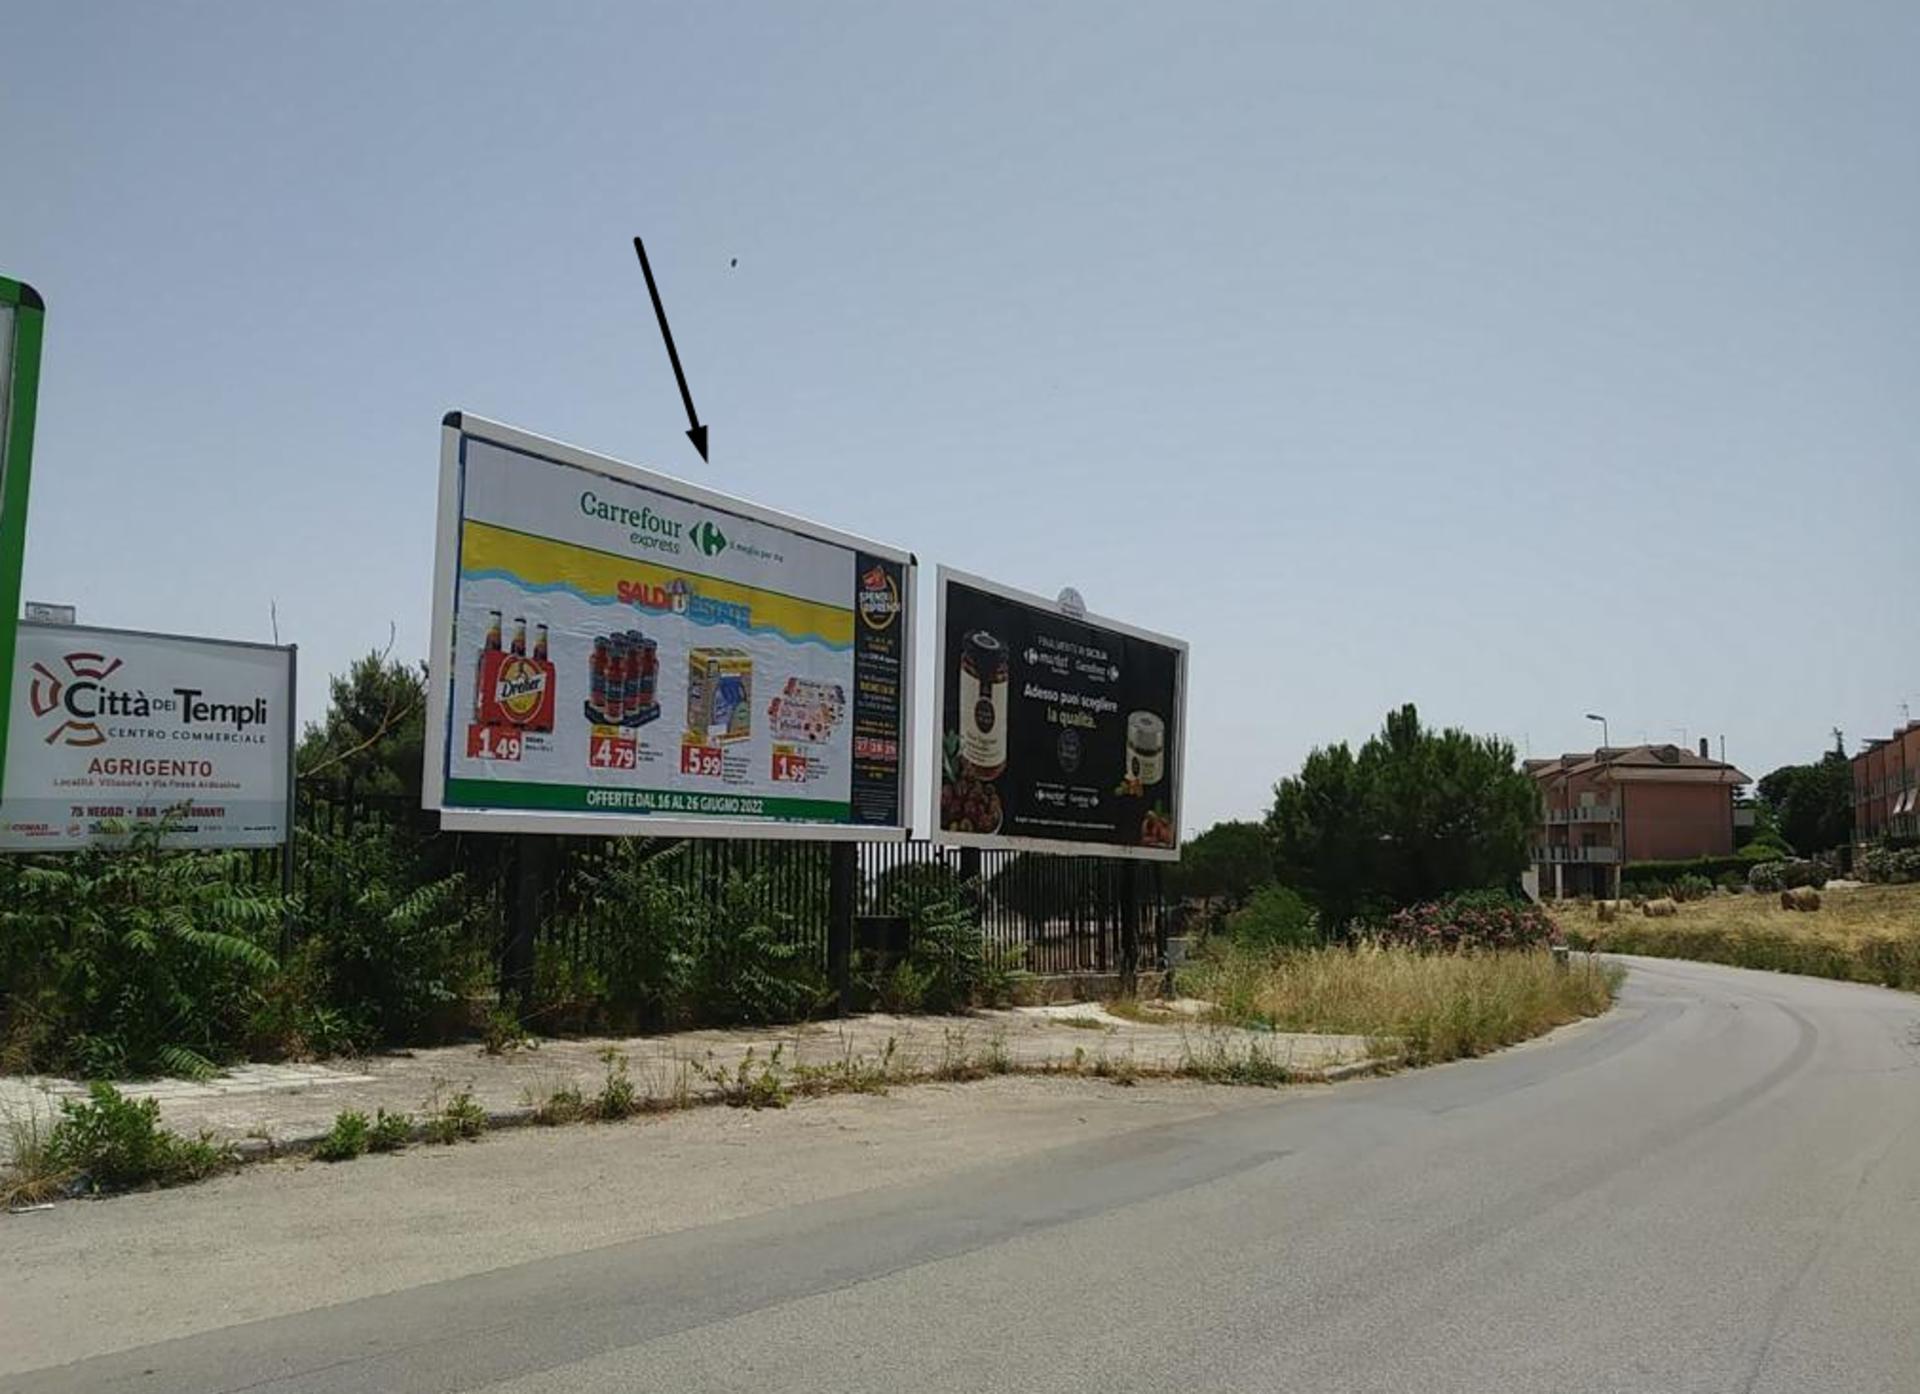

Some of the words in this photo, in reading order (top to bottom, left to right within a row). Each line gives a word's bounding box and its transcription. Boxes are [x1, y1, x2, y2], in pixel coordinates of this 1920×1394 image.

[580, 491, 682, 538] Carrefour
[629, 531, 681, 555] express
[501, 677, 541, 698] Dreher
[1024, 683, 1059, 702] Adesso
[64, 681, 149, 718] Città
[152, 698, 177, 711] DEI
[173, 688, 267, 731] Templi
[1047, 703, 1058, 722] la
[108, 727, 166, 740] CENTRO
[172, 730, 266, 743] COMMERCIALE
[87, 757, 213, 777] AGRIGENTO
[586, 790, 636, 808] OFFERTE
[635, 792, 656, 808] DAL
[670, 794, 684, 810] AL
[699, 796, 740, 812] GIUGNO
[740, 797, 763, 813] 2022
